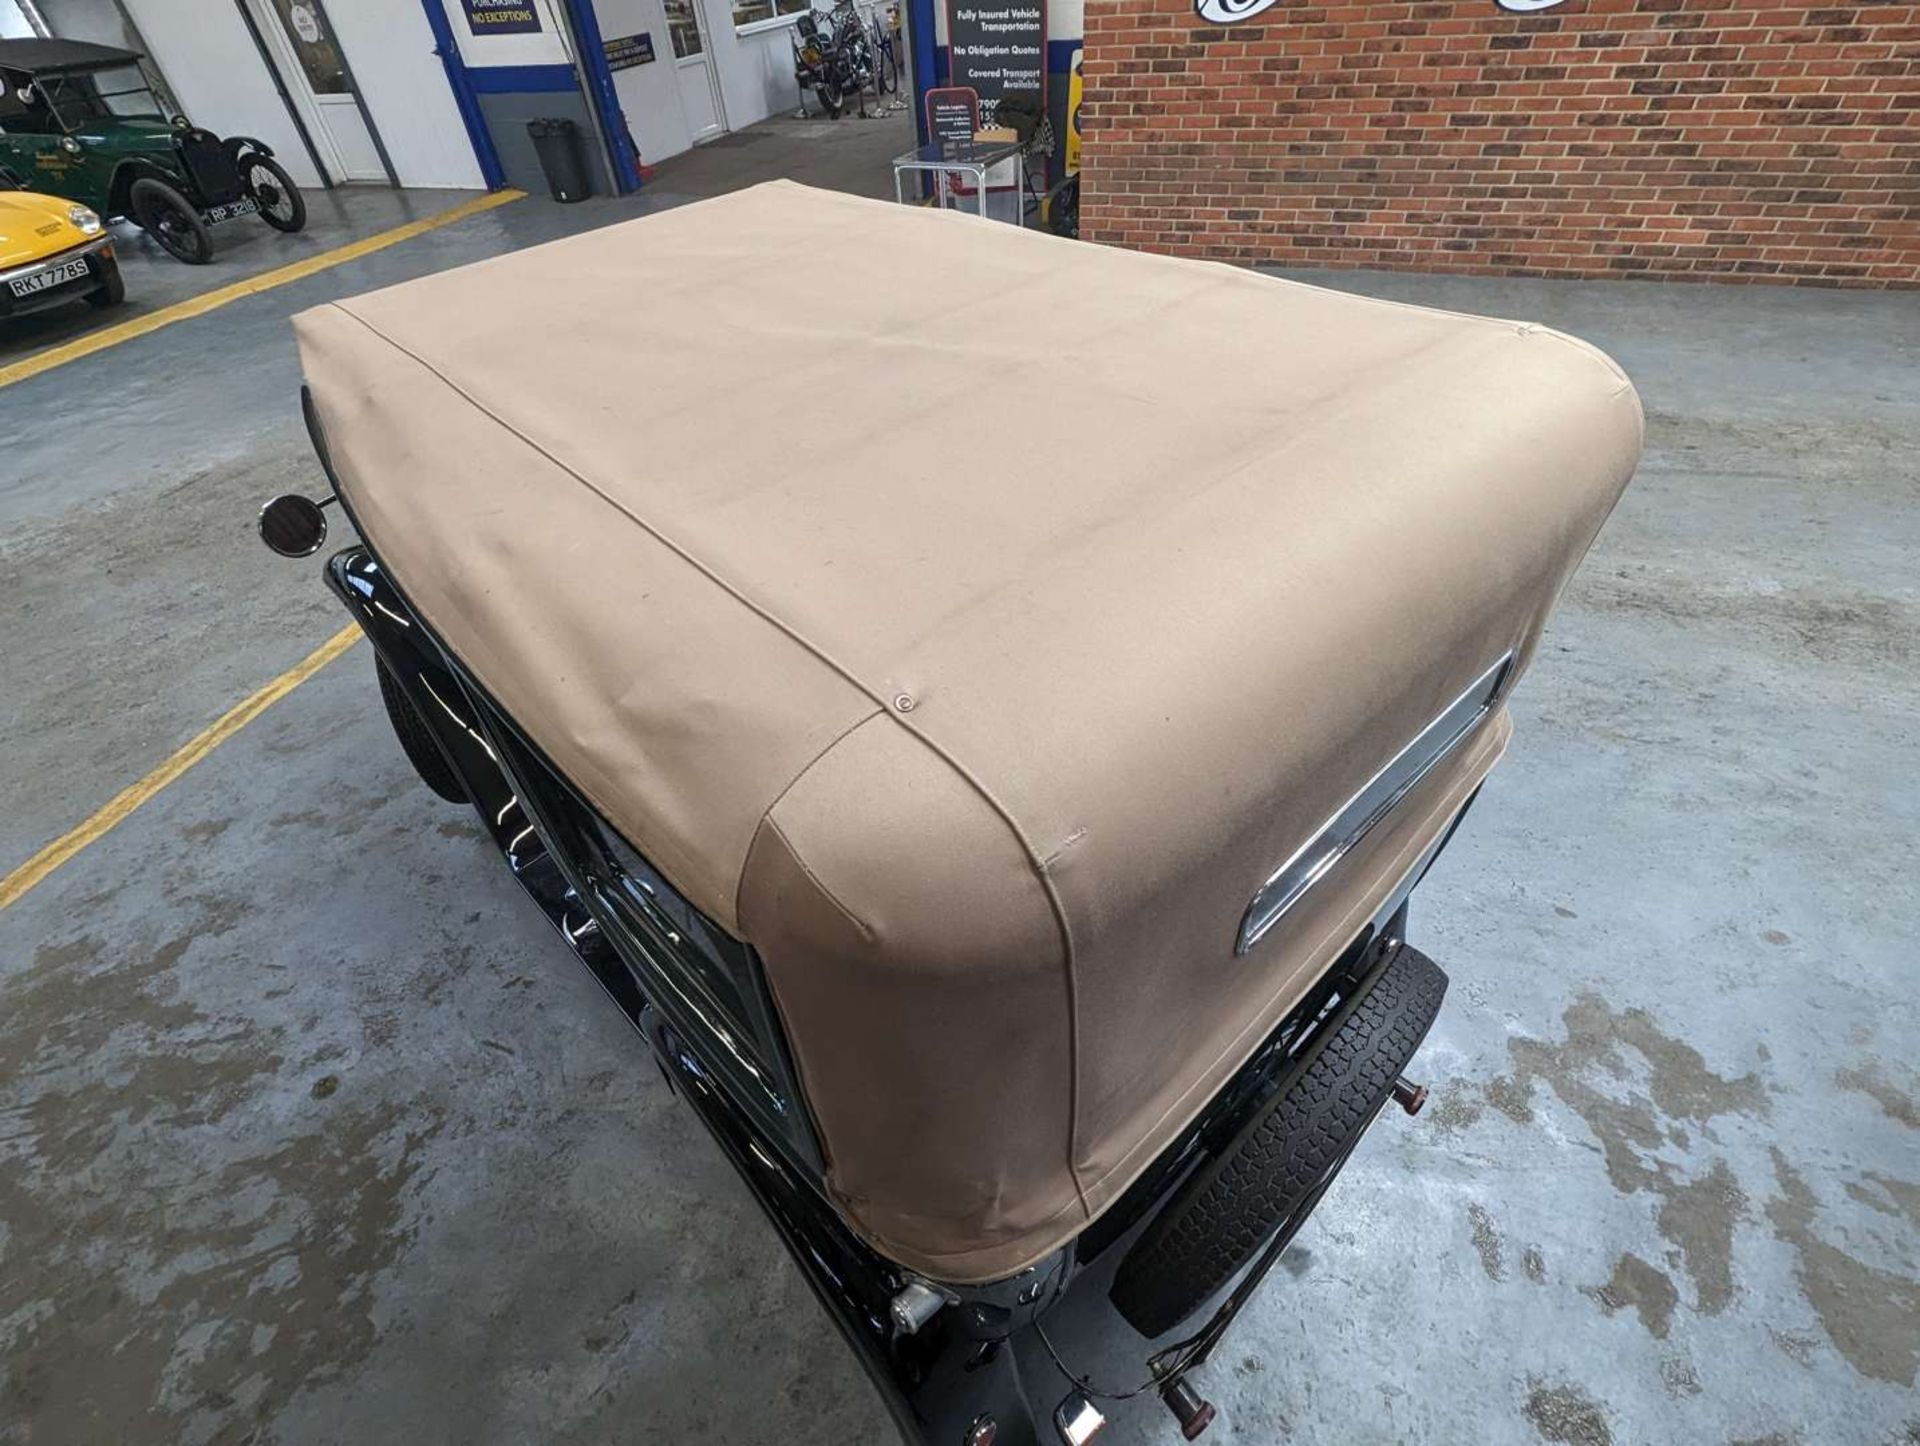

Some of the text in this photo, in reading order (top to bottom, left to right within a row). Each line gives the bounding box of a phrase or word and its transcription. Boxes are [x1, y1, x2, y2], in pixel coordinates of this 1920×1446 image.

[485, 10, 532, 23] EXCEPTIONS
[957, 8, 1040, 21] Fully Insured Vehicle
[981, 22, 1040, 33] Transportation
[954, 45, 1040, 57] No Obligation Quotes
[968, 68, 1040, 79] Covered Transport
[1003, 80, 1040, 89] Available
[211, 206, 227, 222] RP
